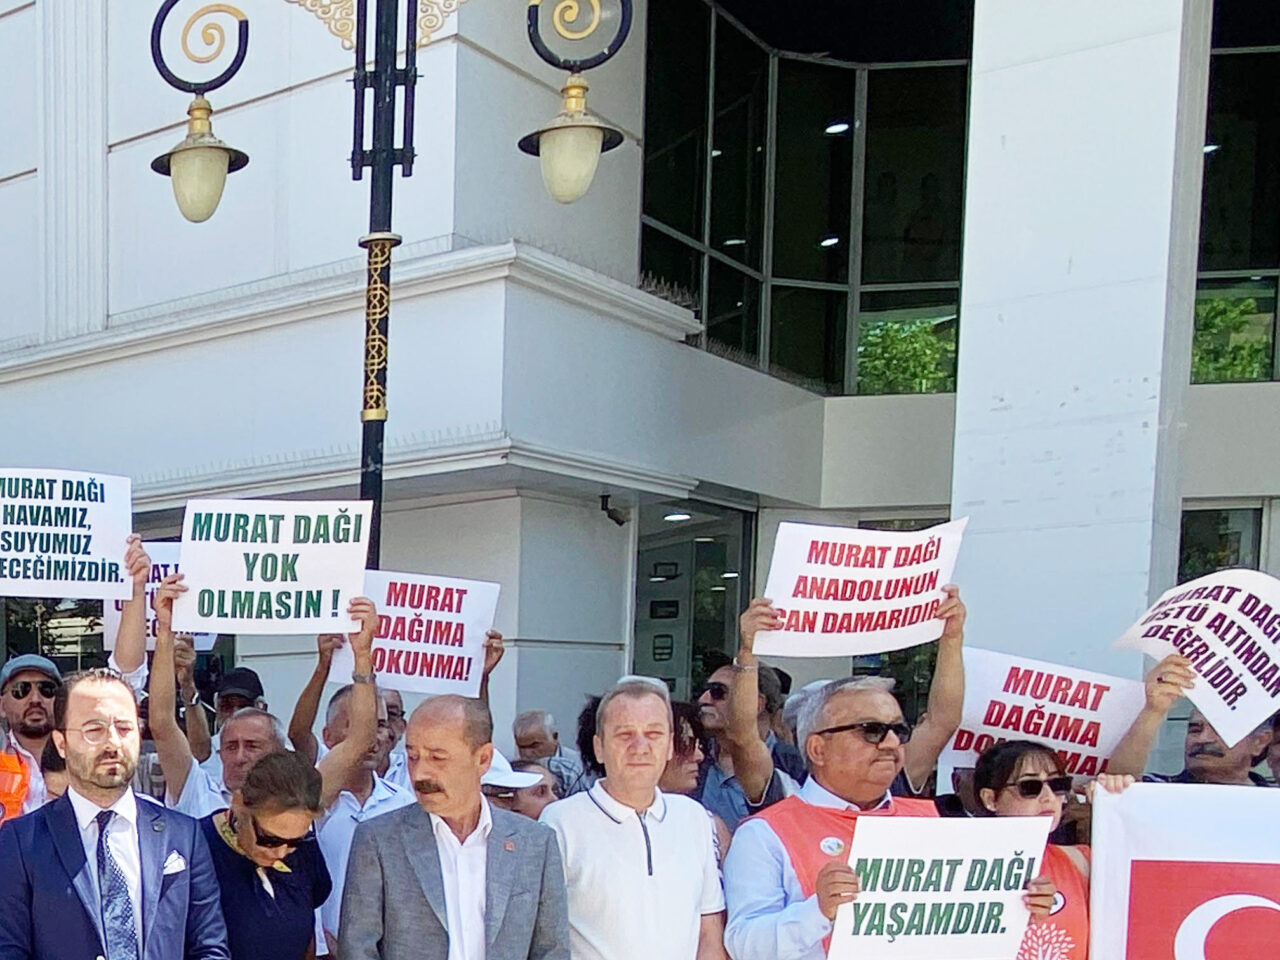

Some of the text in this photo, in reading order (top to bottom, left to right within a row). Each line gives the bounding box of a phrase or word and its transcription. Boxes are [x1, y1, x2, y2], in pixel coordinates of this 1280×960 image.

[61, 477, 105, 503] DAĞI
[2, 504, 92, 531] HAVAMIZ,
[190, 507, 363, 544] MURAT DAĞI
[0, 530, 92, 556] SUYUMUZ
[806, 535, 942, 569] MURAT DAĞI
[243, 552, 300, 582] YOK
[385, 581, 468, 614] MURAT
[791, 568, 941, 602] ANADOLUNUN
[197, 588, 341, 620] OLMASIN !
[374, 612, 465, 648] DAĞIMA
[371, 646, 473, 681] OKUNMA!
[1141, 623, 1249, 711] DEĞERLİDİR.
[1002, 665, 1111, 713] MURAT
[982, 699, 1101, 749] DAĞIMA
[952, 728, 1110, 777] DOMA!
[855, 850, 1036, 893] MURAT DAĞI
[851, 901, 1007, 943] YAŞAMDIR.
